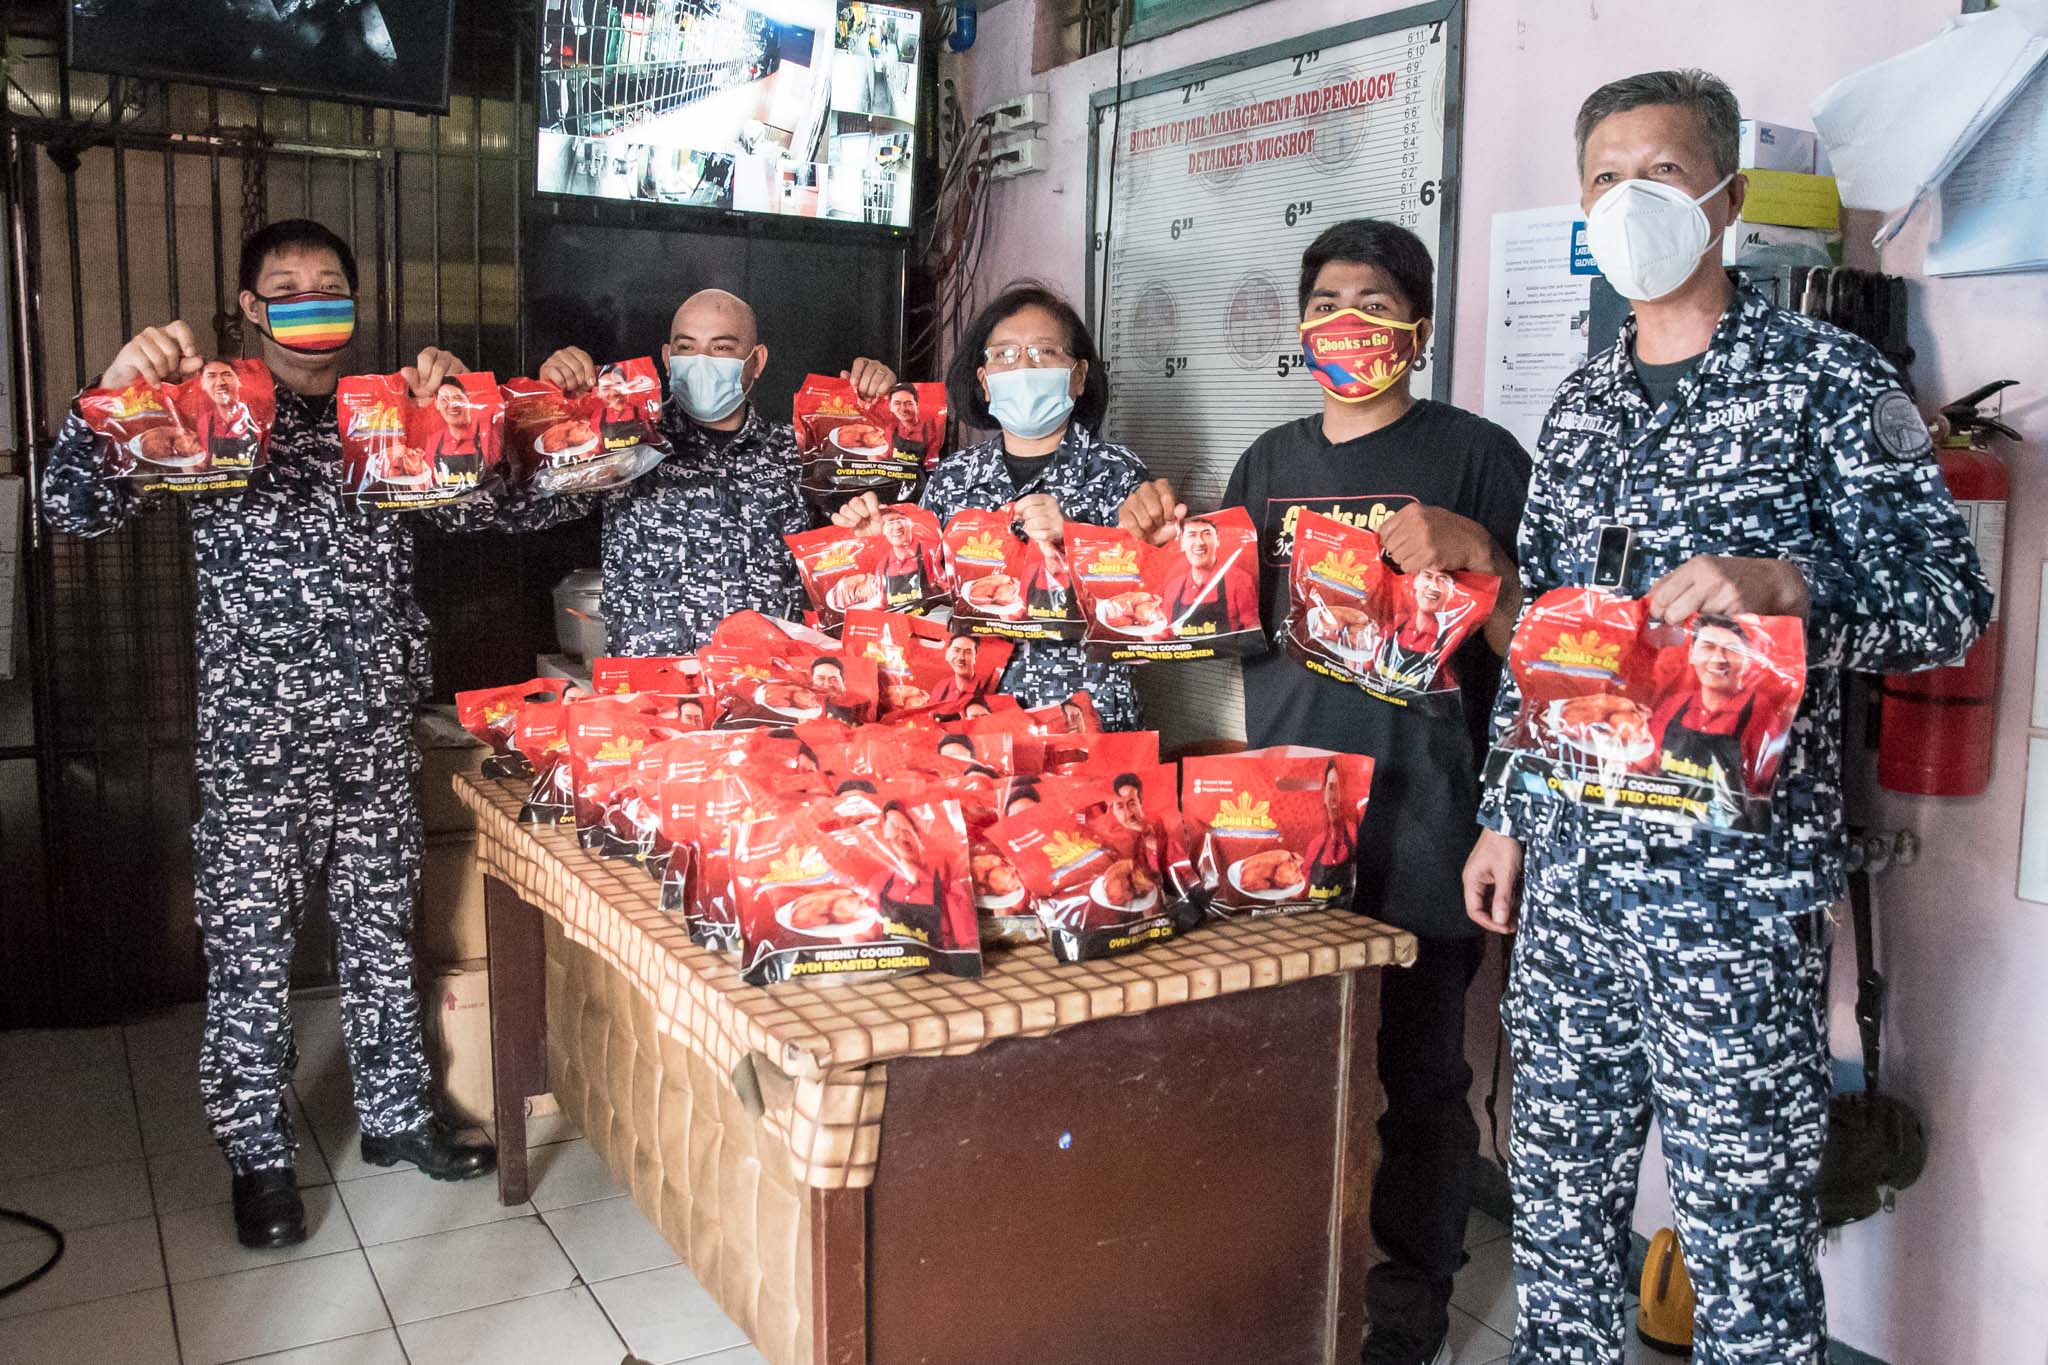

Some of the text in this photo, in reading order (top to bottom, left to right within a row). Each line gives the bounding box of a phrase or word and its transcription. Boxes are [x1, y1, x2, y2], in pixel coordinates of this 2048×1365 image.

[1129, 72, 1396, 152] BUREAU OF JAIL MANAGEMENT AND PENOLOGY
[1188, 129, 1315, 174] DETAINEE'S MUGSHOT
[1316, 336, 1360, 353] Chooks
[1372, 333, 1389, 347] Go
[836, 468, 855, 476] OVEN
[887, 470, 917, 479] CHICKEN
[877, 463, 903, 472] COOKED
[144, 480, 248, 491] OVEN ROASTED CHICKEN
[1111, 649, 1214, 660] OVEN ROASTED CHICKEN
[1159, 643, 1192, 651] COOKED
[1366, 688, 1408, 707] CHICKEN
[1628, 780, 1681, 795] COOKED
[815, 946, 905, 961] FRESHLY COOKED
[792, 956, 930, 976] OVEN ROASTED CHICKEN
